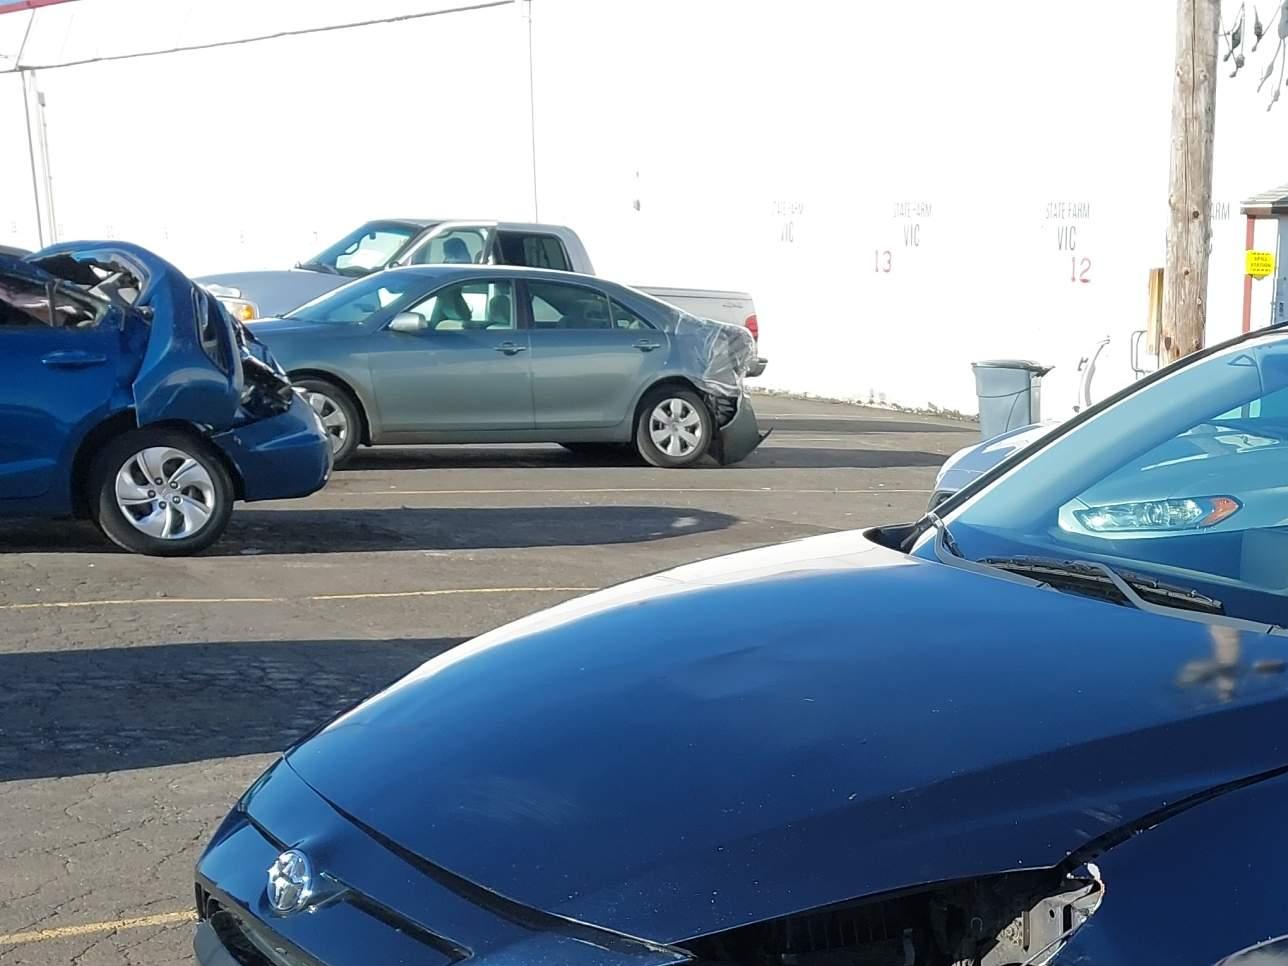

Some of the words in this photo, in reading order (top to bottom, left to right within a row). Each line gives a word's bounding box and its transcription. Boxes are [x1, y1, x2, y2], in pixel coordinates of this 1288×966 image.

[1045, 201, 1066, 219] STATE
[1067, 201, 1090, 219] FARM
[903, 223, 921, 248] VIC
[1057, 224, 1077, 251] VIC
[873, 248, 894, 274] 13
[1070, 255, 1092, 283] 12
